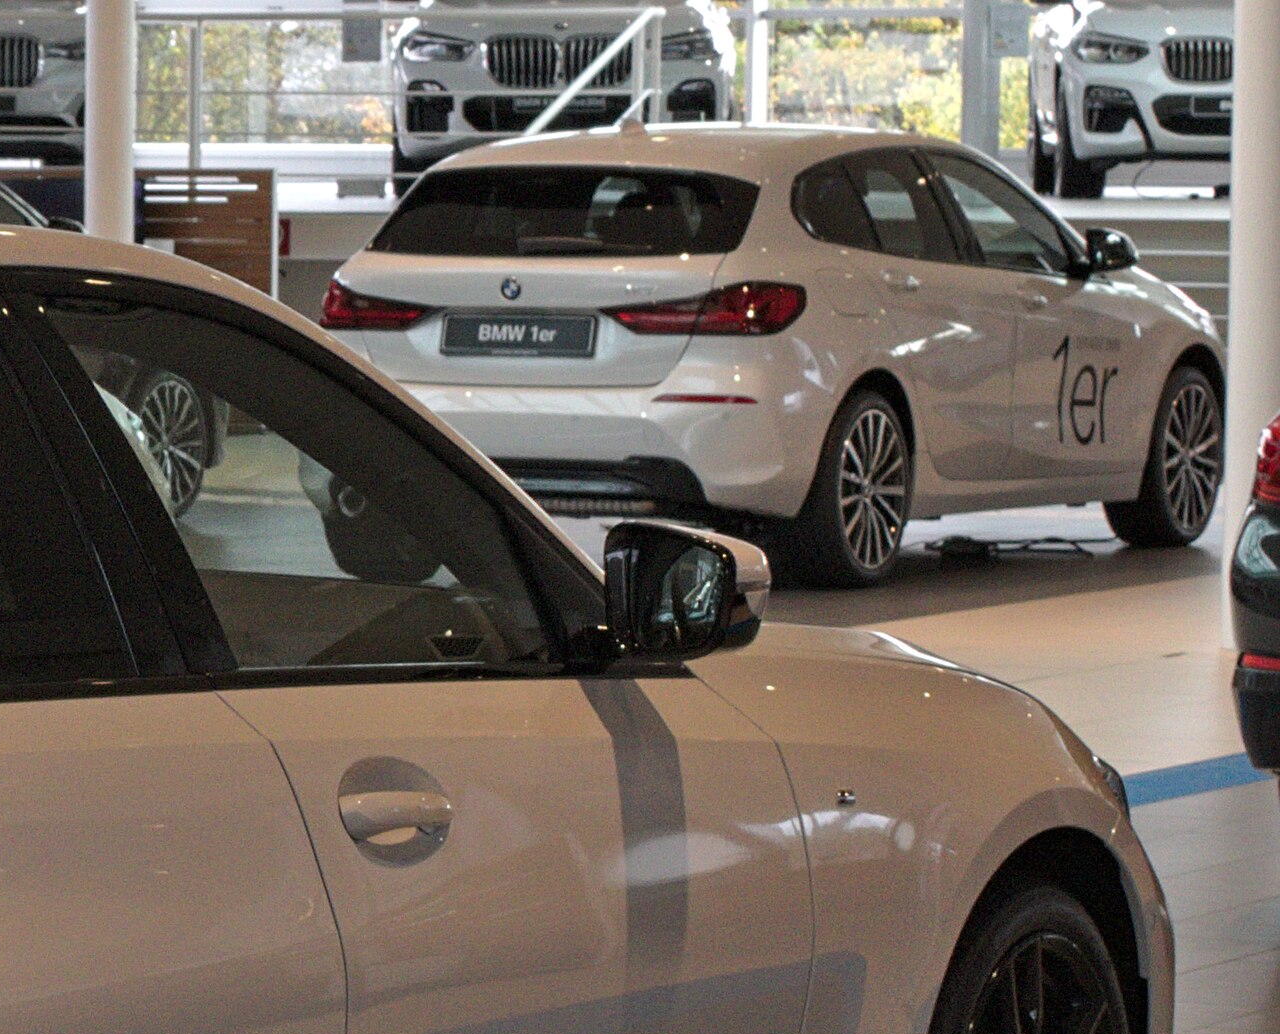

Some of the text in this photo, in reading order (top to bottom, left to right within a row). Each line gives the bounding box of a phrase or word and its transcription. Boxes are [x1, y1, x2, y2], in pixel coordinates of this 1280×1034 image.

[478, 323, 557, 343] BMW 1er
[1051, 335, 1119, 445] 1er
